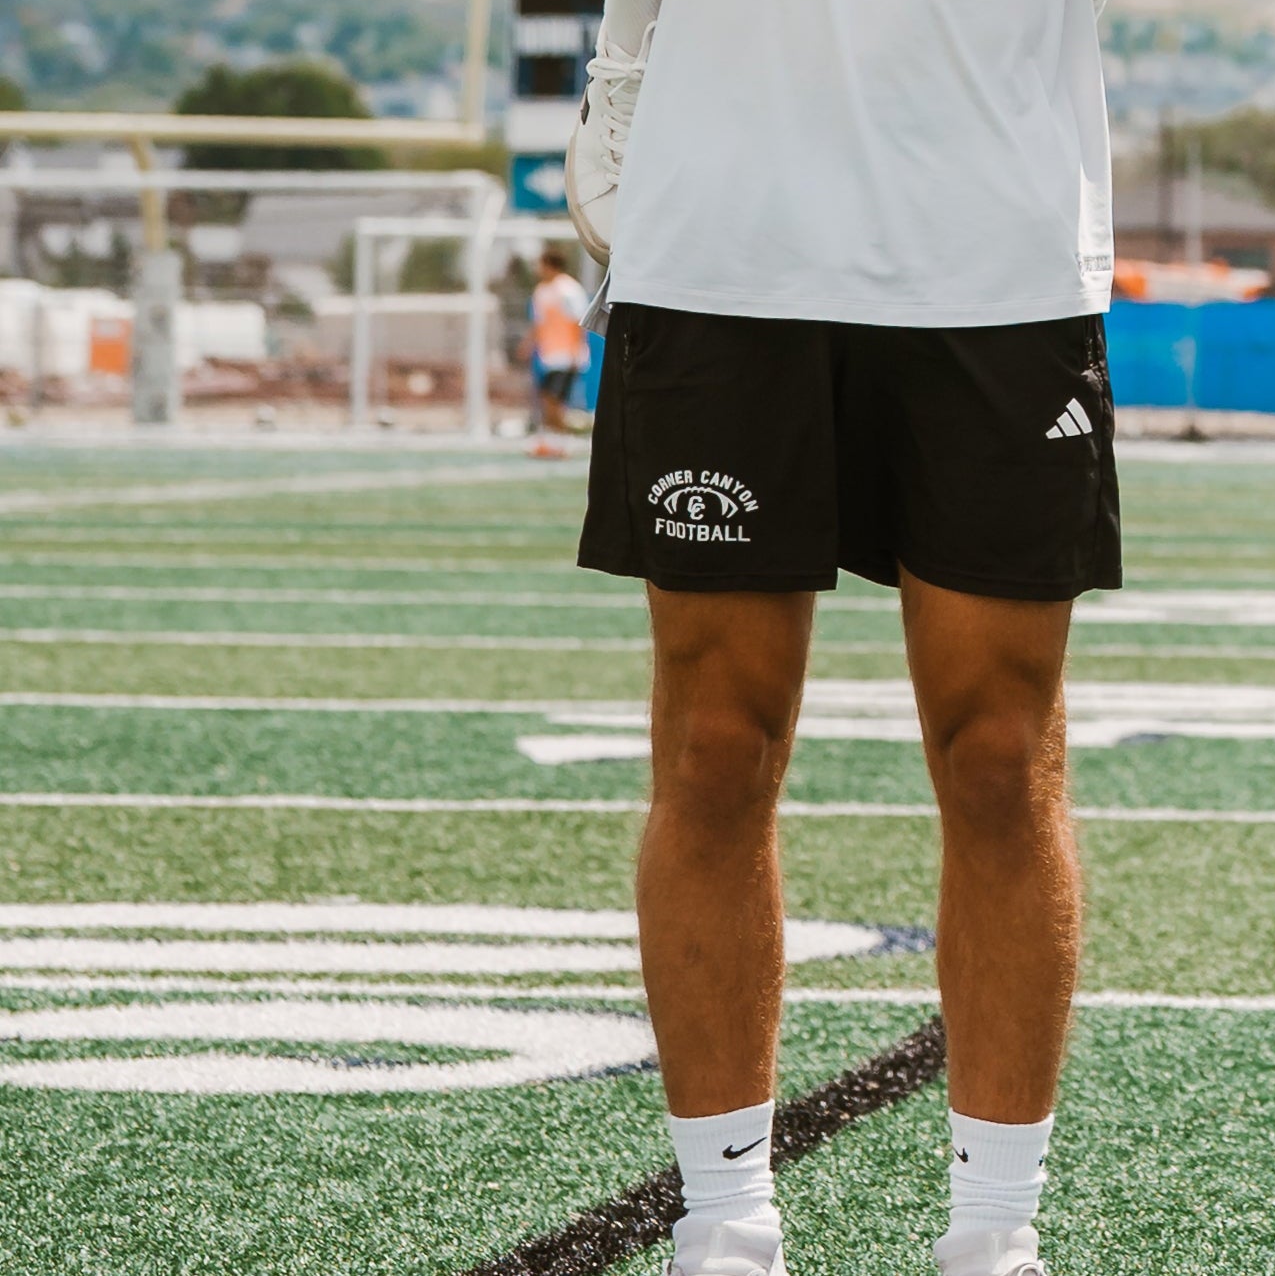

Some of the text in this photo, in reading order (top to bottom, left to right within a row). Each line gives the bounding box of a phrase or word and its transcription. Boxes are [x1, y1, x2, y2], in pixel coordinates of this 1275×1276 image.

[647, 469, 759, 513] CORNER CANYON
[655, 517, 751, 542] FOOTBALL
